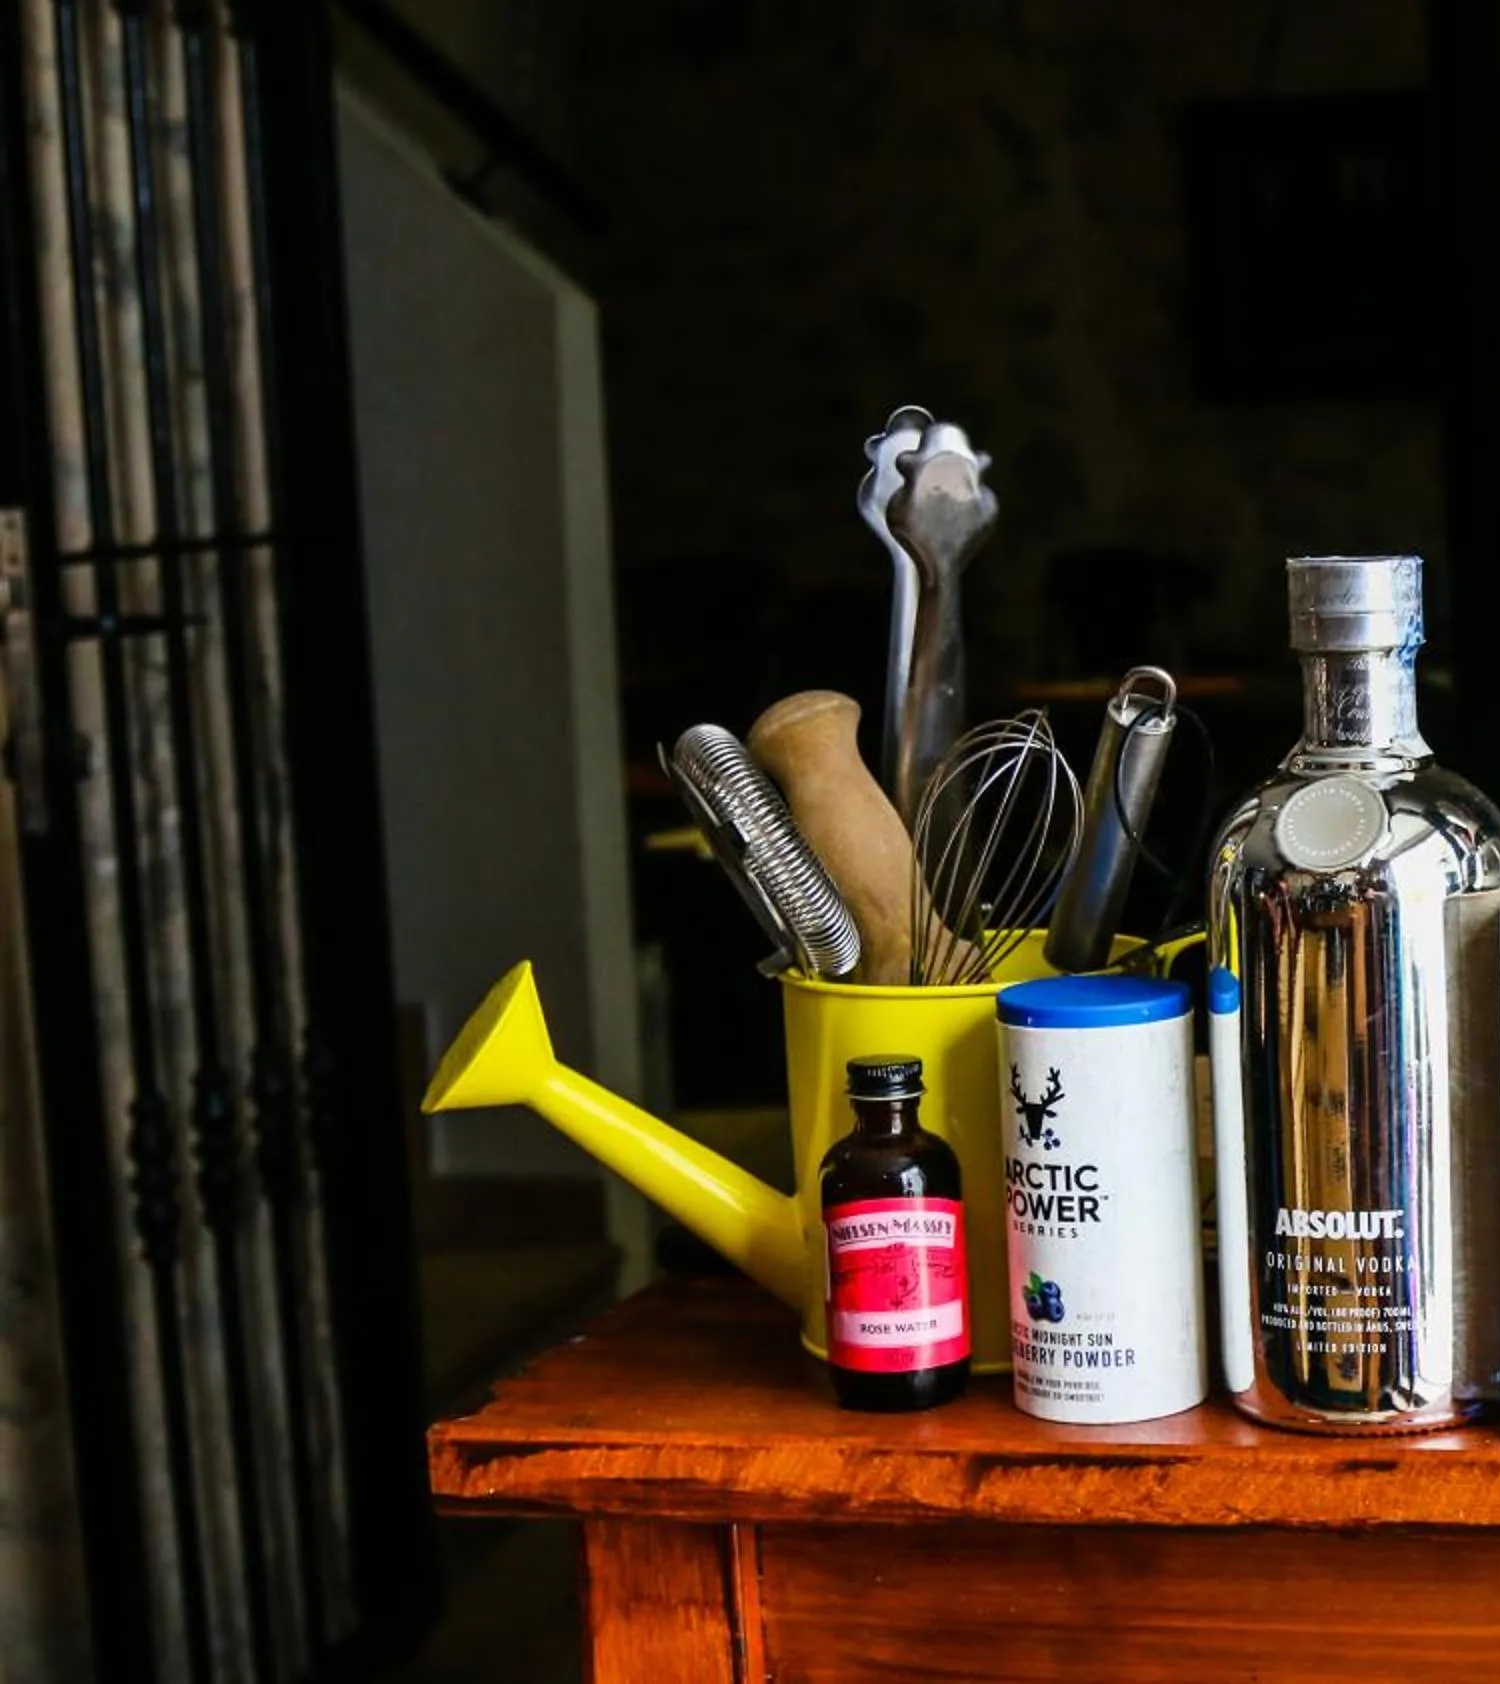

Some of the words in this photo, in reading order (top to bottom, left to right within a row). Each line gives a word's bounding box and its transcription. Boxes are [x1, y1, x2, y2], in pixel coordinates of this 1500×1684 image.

[1266, 1250, 1346, 1273] ORIGINAL
[1356, 1254, 1417, 1274] VODKA
[1287, 1283, 1338, 1297] IMORTED
[859, 1322, 892, 1335] ROSE
[1031, 1327, 1083, 1347] MIDNIGHT
[1087, 1332, 1113, 1347] SUN
[1297, 1341, 1338, 1354] LMITED
[1342, 1342, 1387, 1354] EDITION
[1063, 1348, 1136, 1369] POWDER
